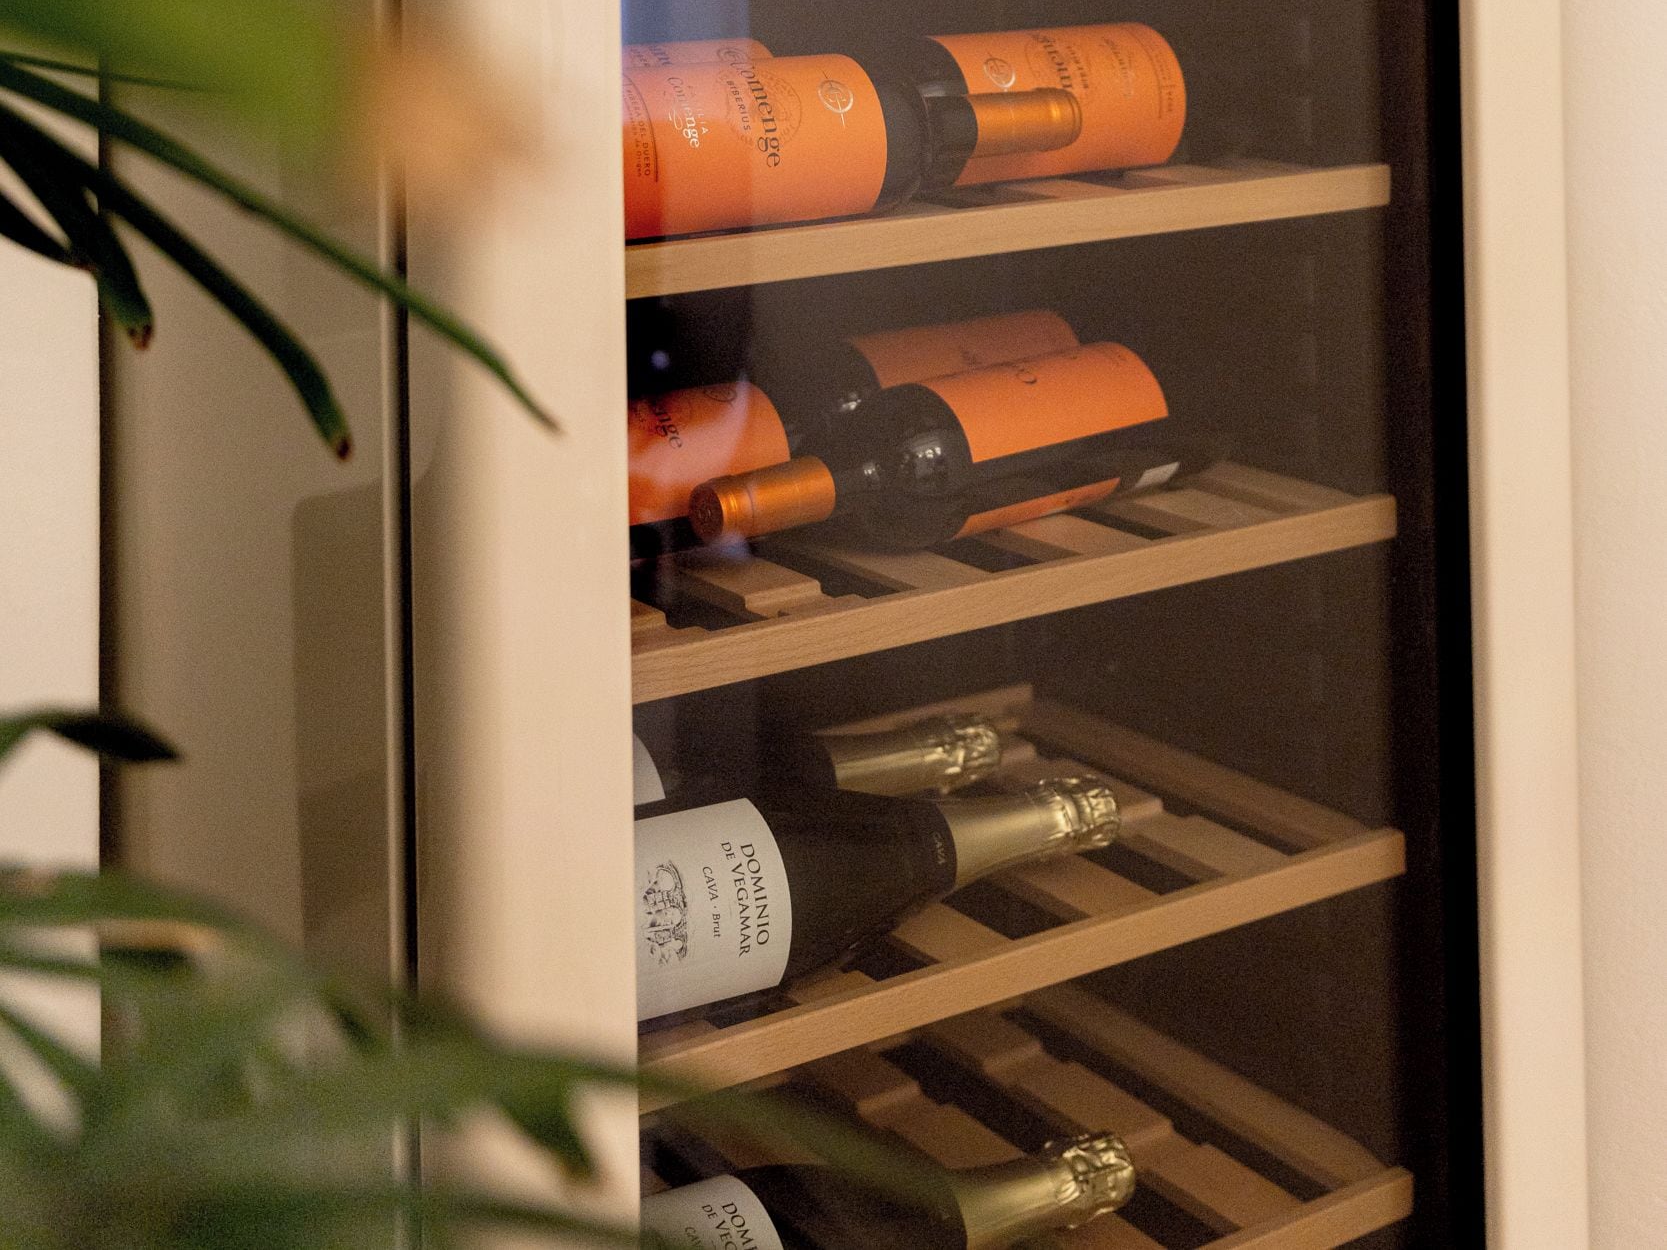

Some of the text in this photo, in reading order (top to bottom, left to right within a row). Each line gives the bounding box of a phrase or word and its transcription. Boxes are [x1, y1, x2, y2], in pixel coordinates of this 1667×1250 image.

[729, 61, 781, 168] Comenge
[642, 142, 651, 177] DUERO
[702, 866, 721, 938] CAVA Brut
[720, 841, 751, 958] DE VEGAMAR
[740, 843, 770, 945] DOMINIO
[701, 1204, 718, 1220] DE
